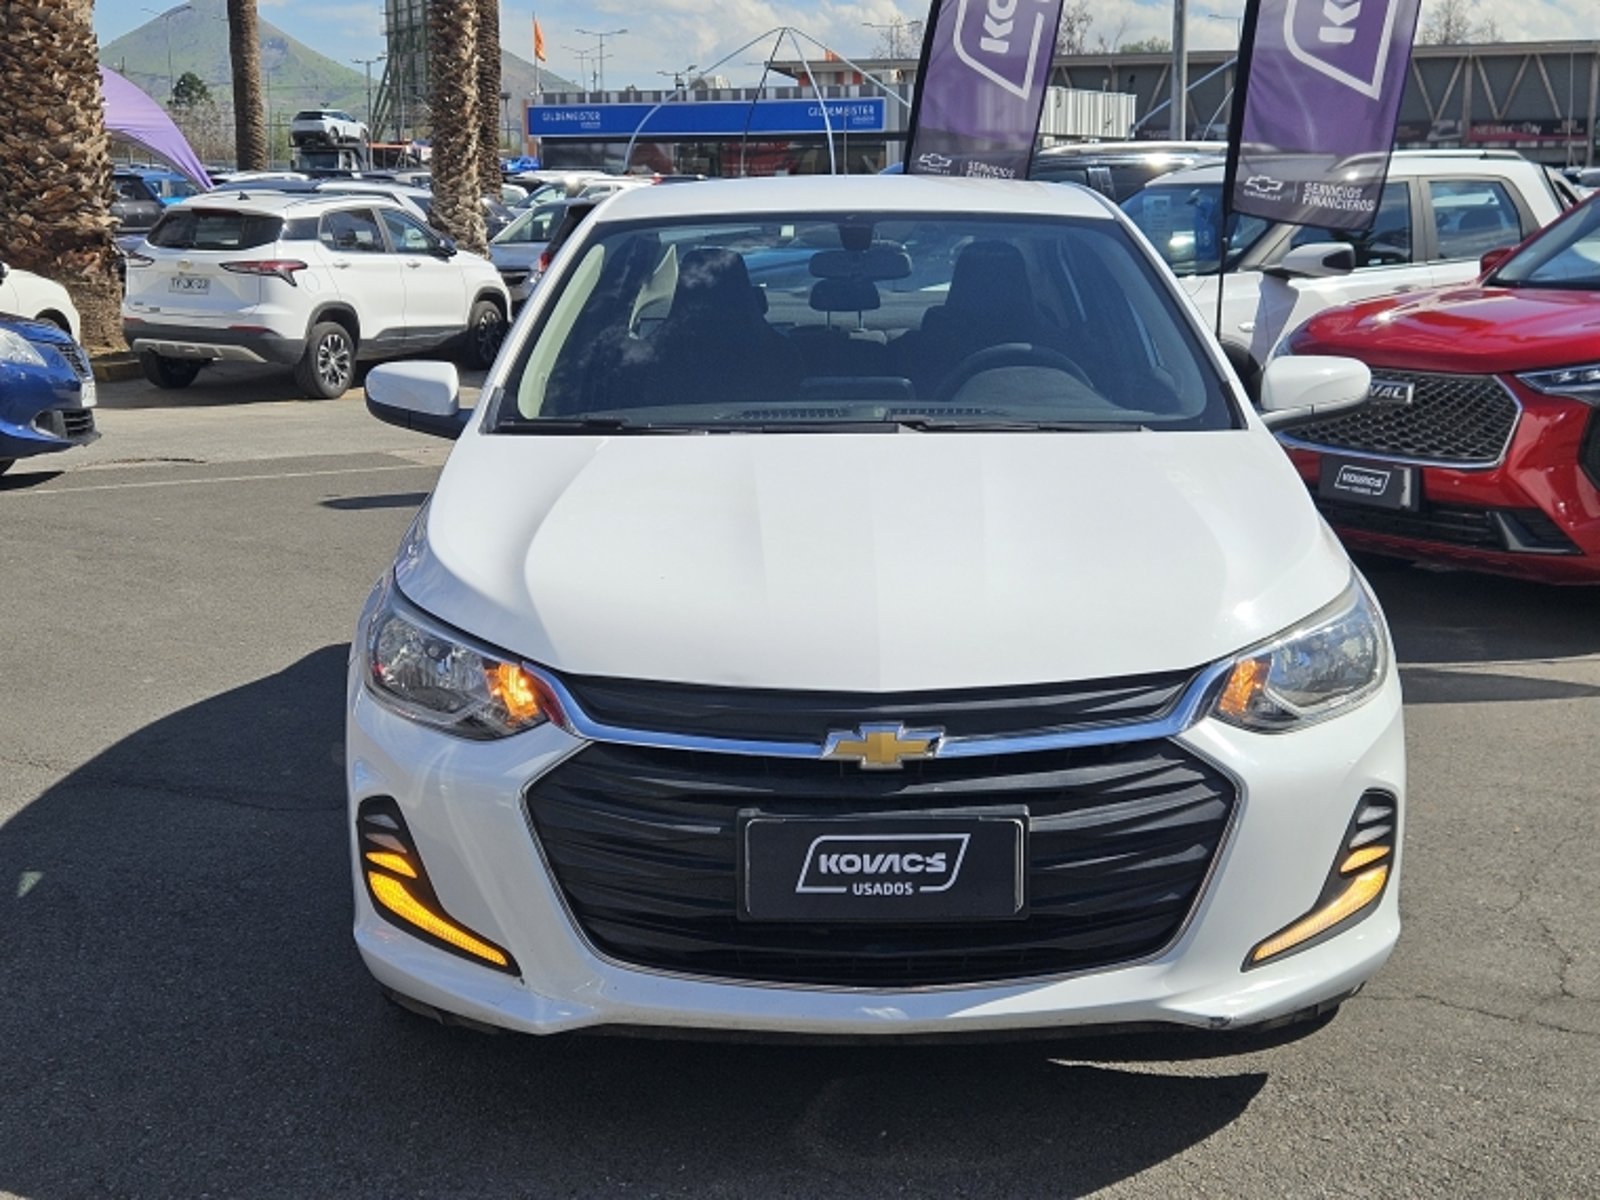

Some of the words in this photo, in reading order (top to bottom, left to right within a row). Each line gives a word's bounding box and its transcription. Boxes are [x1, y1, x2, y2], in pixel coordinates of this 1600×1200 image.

[1304, 182, 1363, 199] SERVICIOS
[1302, 193, 1375, 212] FINANCIEROS
[819, 853, 947, 874] KOVACS
[852, 882, 914, 896] USADOS
